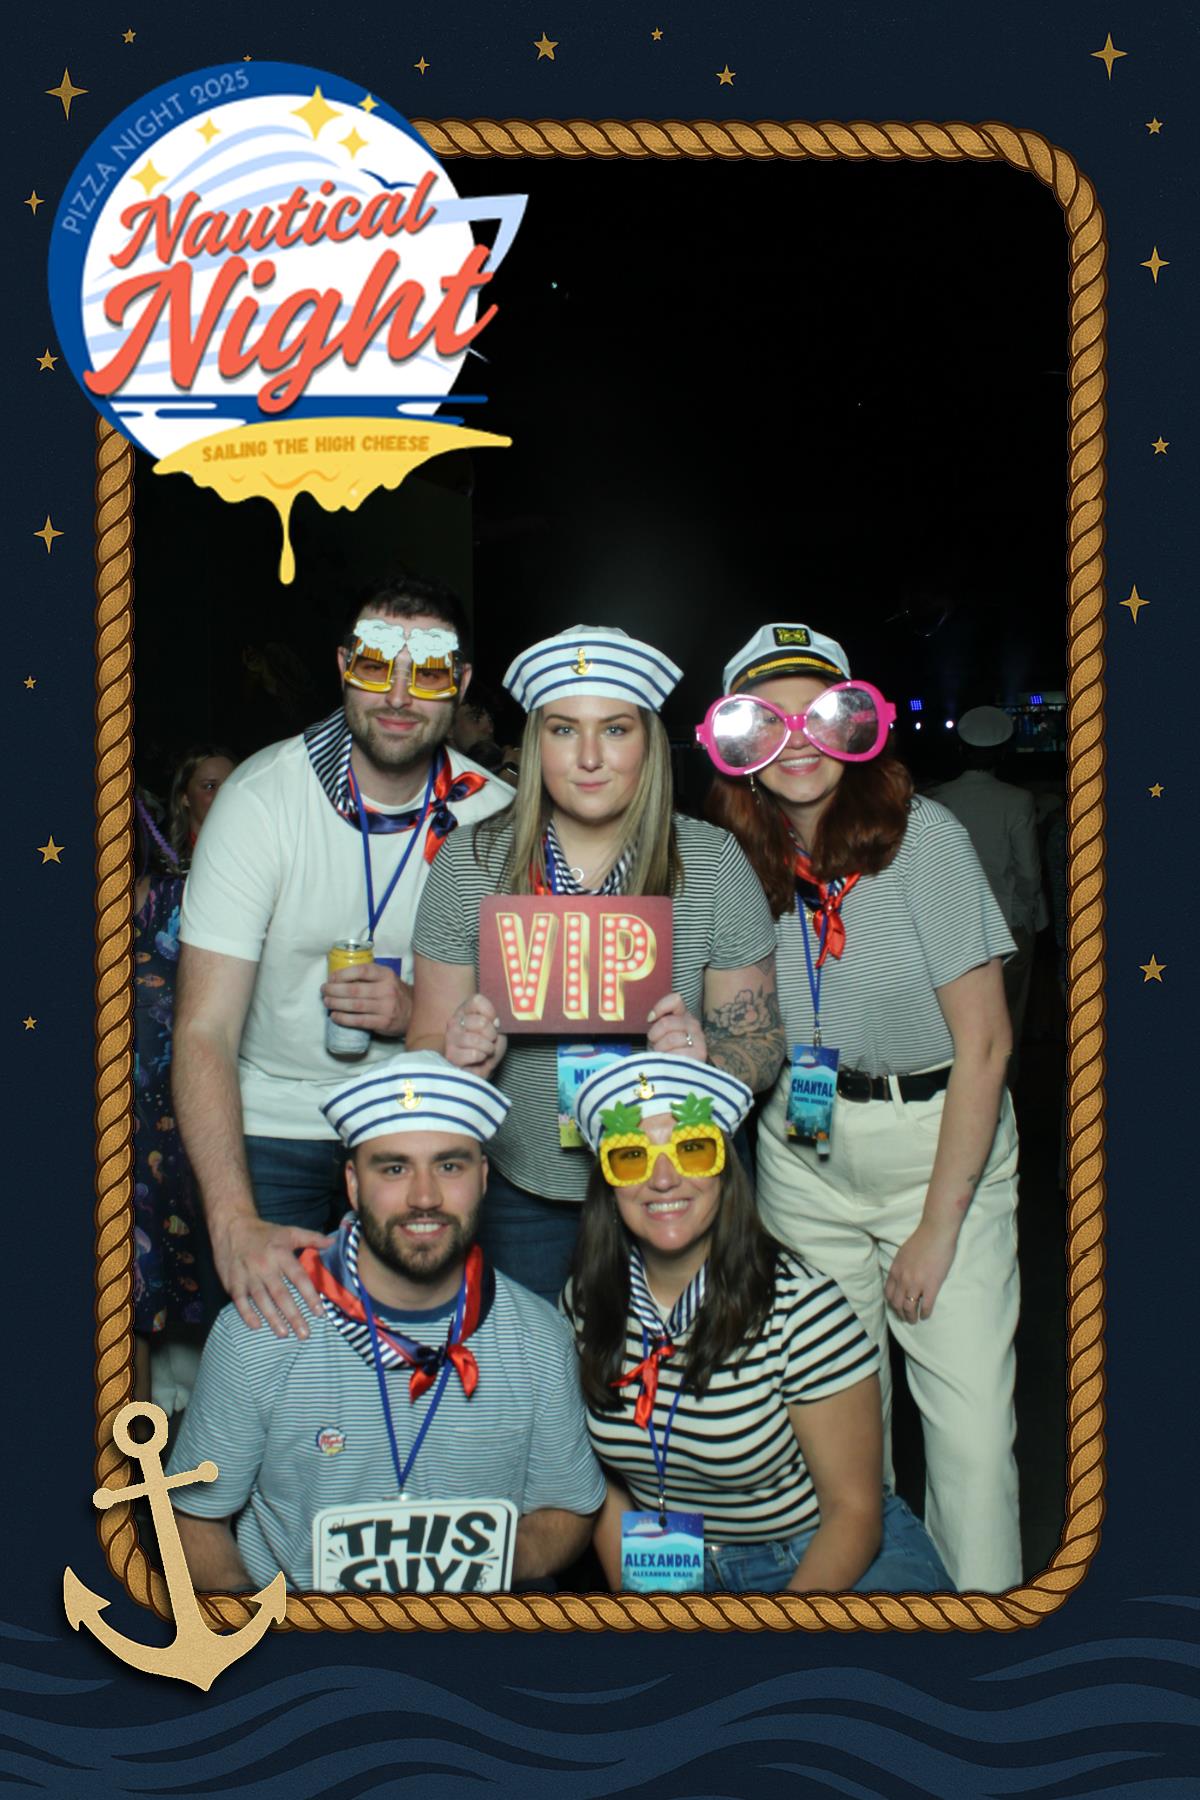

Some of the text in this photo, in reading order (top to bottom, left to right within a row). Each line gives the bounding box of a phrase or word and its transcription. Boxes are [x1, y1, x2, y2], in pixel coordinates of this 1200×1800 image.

[495, 911, 657, 1021] VIP
[791, 1078, 834, 1098] CHANTAL
[327, 1511, 498, 1558] THIS
[624, 1553, 701, 1568] ALEXANDRA
